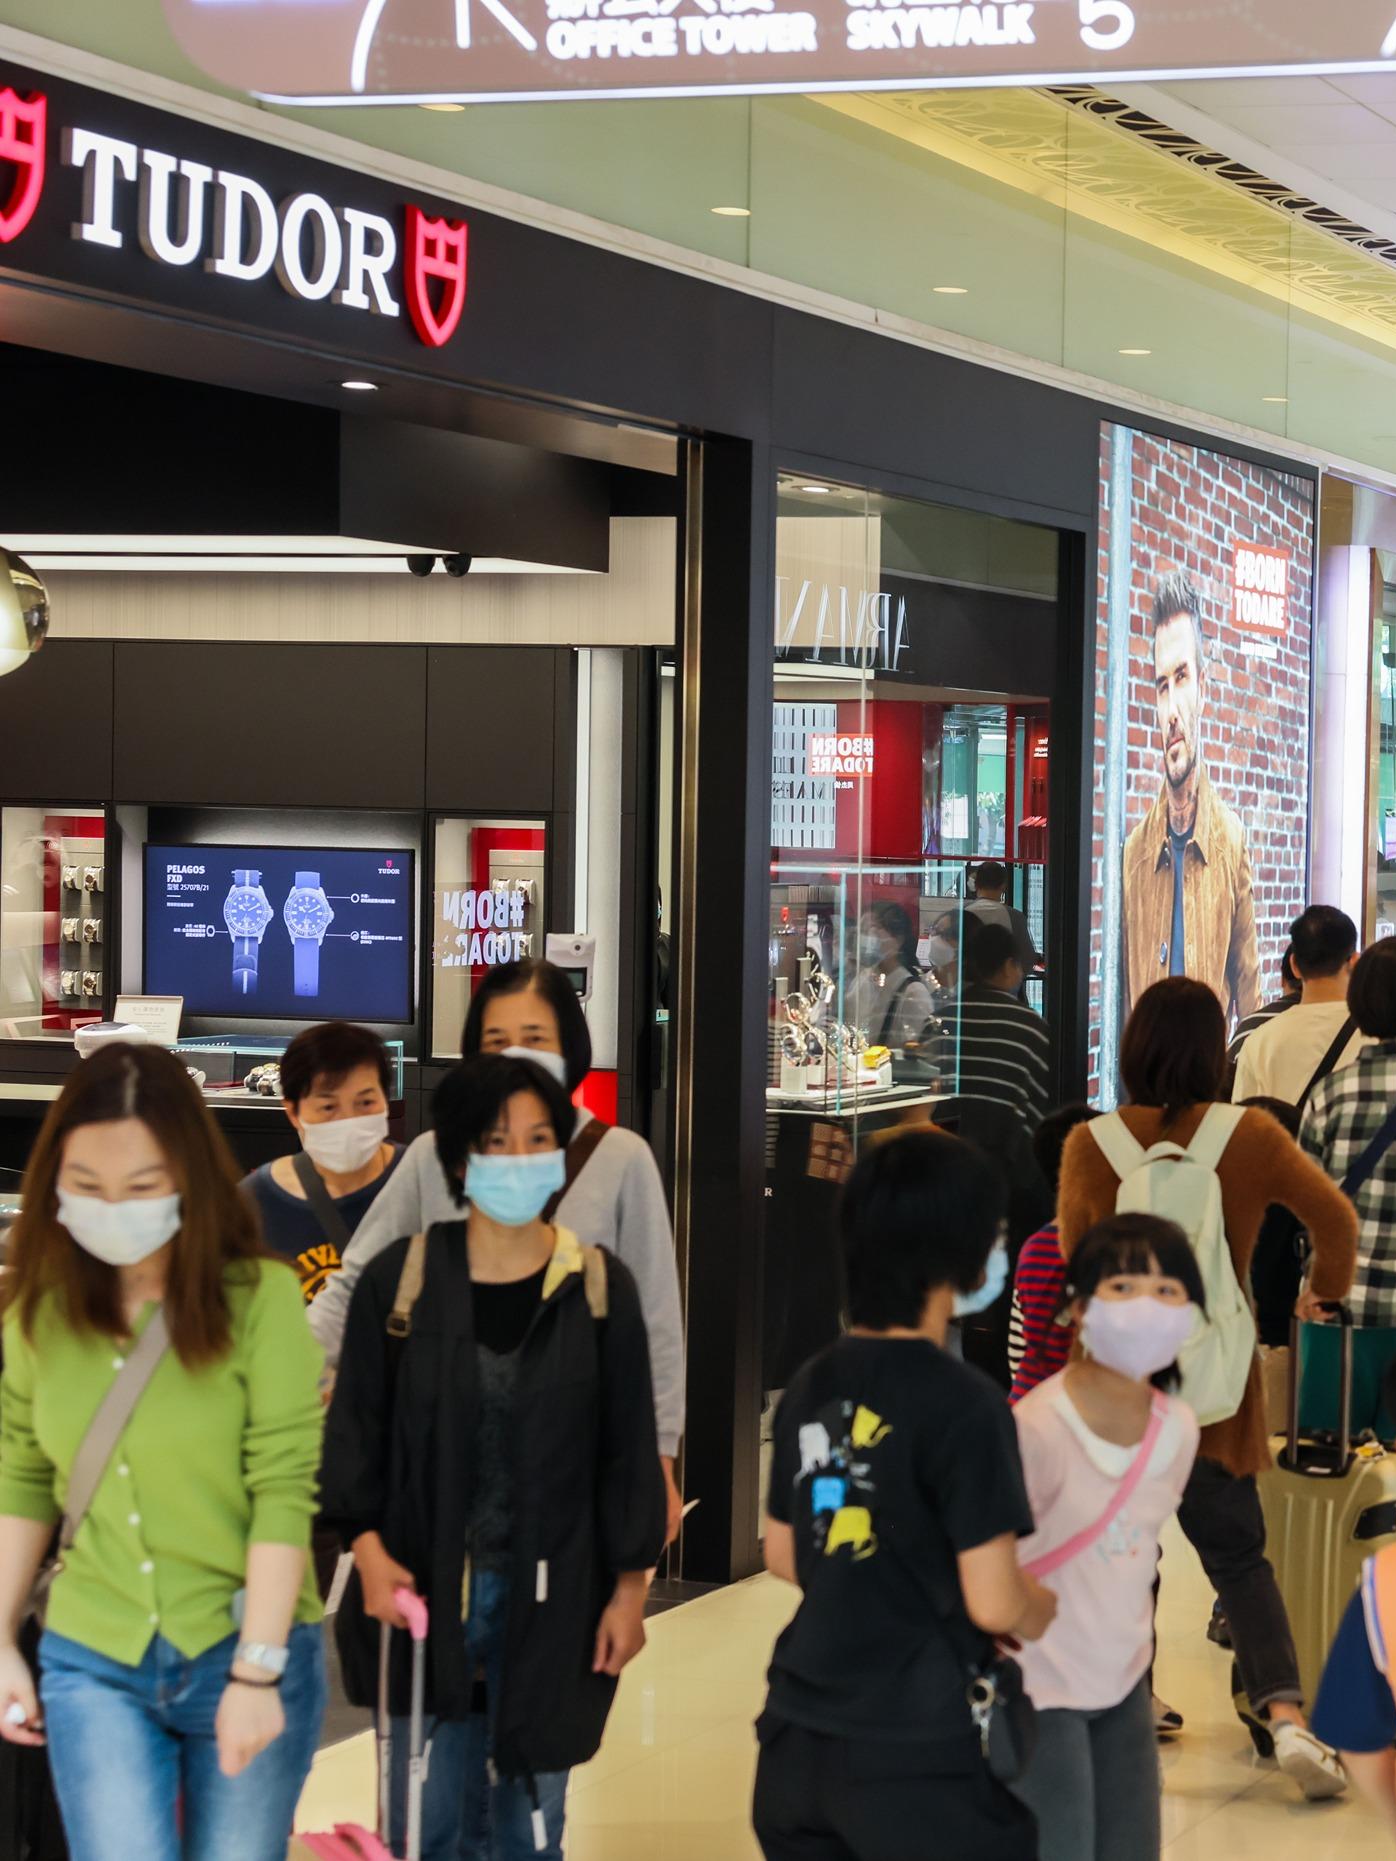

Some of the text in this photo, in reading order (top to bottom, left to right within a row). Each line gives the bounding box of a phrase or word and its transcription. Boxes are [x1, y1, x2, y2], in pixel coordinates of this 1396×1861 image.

[547, 12, 817, 59] OFFICE TOWER
[847, 4, 1035, 50] SKYWALK
[70, 127, 399, 317] TUDOR
[1235, 549, 1286, 595] #BORN
[1234, 588, 1285, 630] TODARE
[167, 865, 205, 874] PELAGOS
[167, 875, 183, 883] FXD
